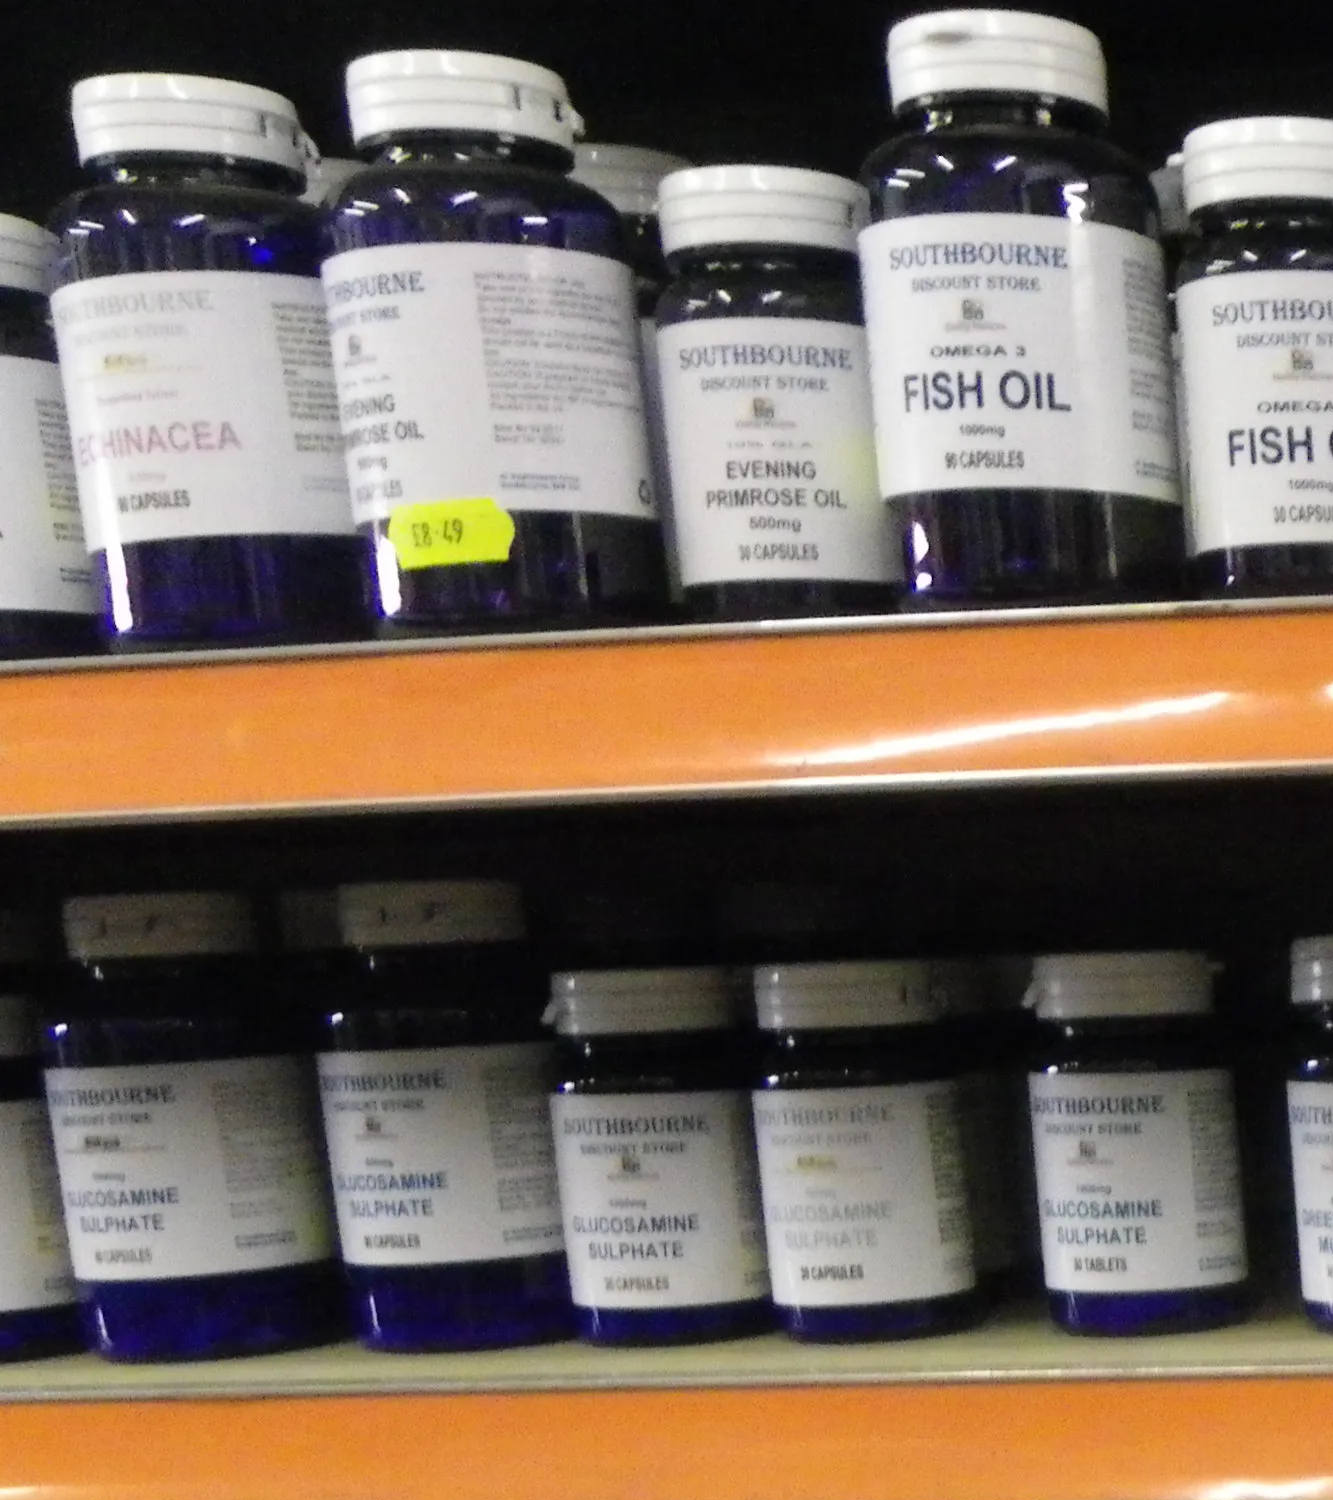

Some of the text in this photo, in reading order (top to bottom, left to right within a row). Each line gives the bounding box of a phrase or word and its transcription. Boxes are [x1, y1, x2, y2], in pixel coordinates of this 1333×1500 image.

[889, 242, 1069, 271] SOUTHBOURNE
[986, 274, 1041, 292] STORE
[679, 343, 852, 371] SOUTHBOURNE
[930, 344, 1009, 359] OMEGA
[903, 371, 1071, 413] FISH OIL
[1228, 427, 1312, 466] FISH
[961, 449, 1025, 469] CAPSULES
[725, 459, 817, 481] EVENING
[705, 487, 846, 509] PRIMROSE OIL
[749, 515, 801, 533] 500mg
[573, 1215, 699, 1234] GLUCOSAMINE
[1057, 1226, 1147, 1245] SULPHATE
[588, 1241, 684, 1259] SULPHATE
